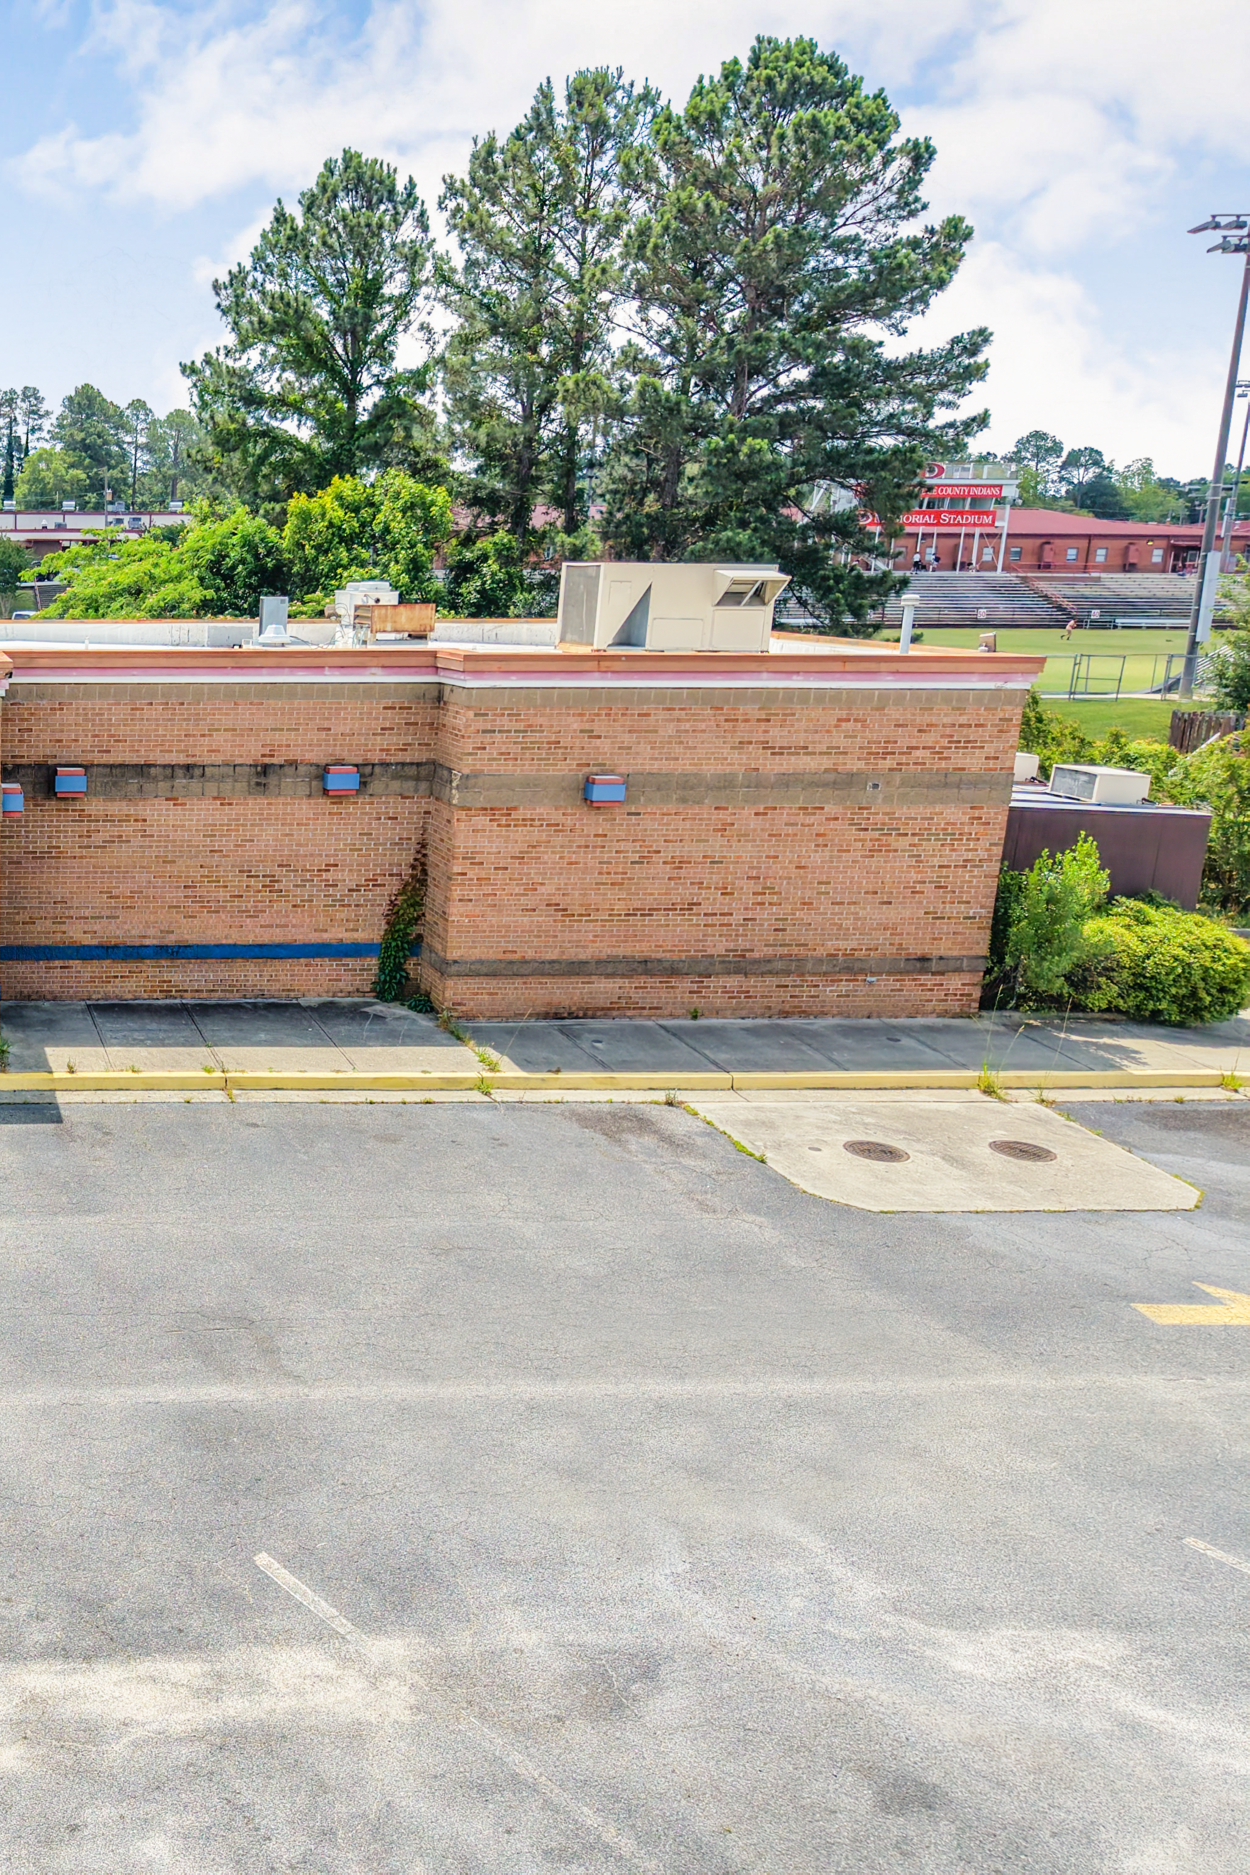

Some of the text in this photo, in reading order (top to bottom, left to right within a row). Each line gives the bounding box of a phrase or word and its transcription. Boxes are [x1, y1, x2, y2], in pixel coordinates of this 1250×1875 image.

[938, 486, 970, 496] COUNTY
[970, 486, 1000, 496] INDIANS
[939, 513, 993, 524] STADIUM
[978, 610, 986, 618] 50
